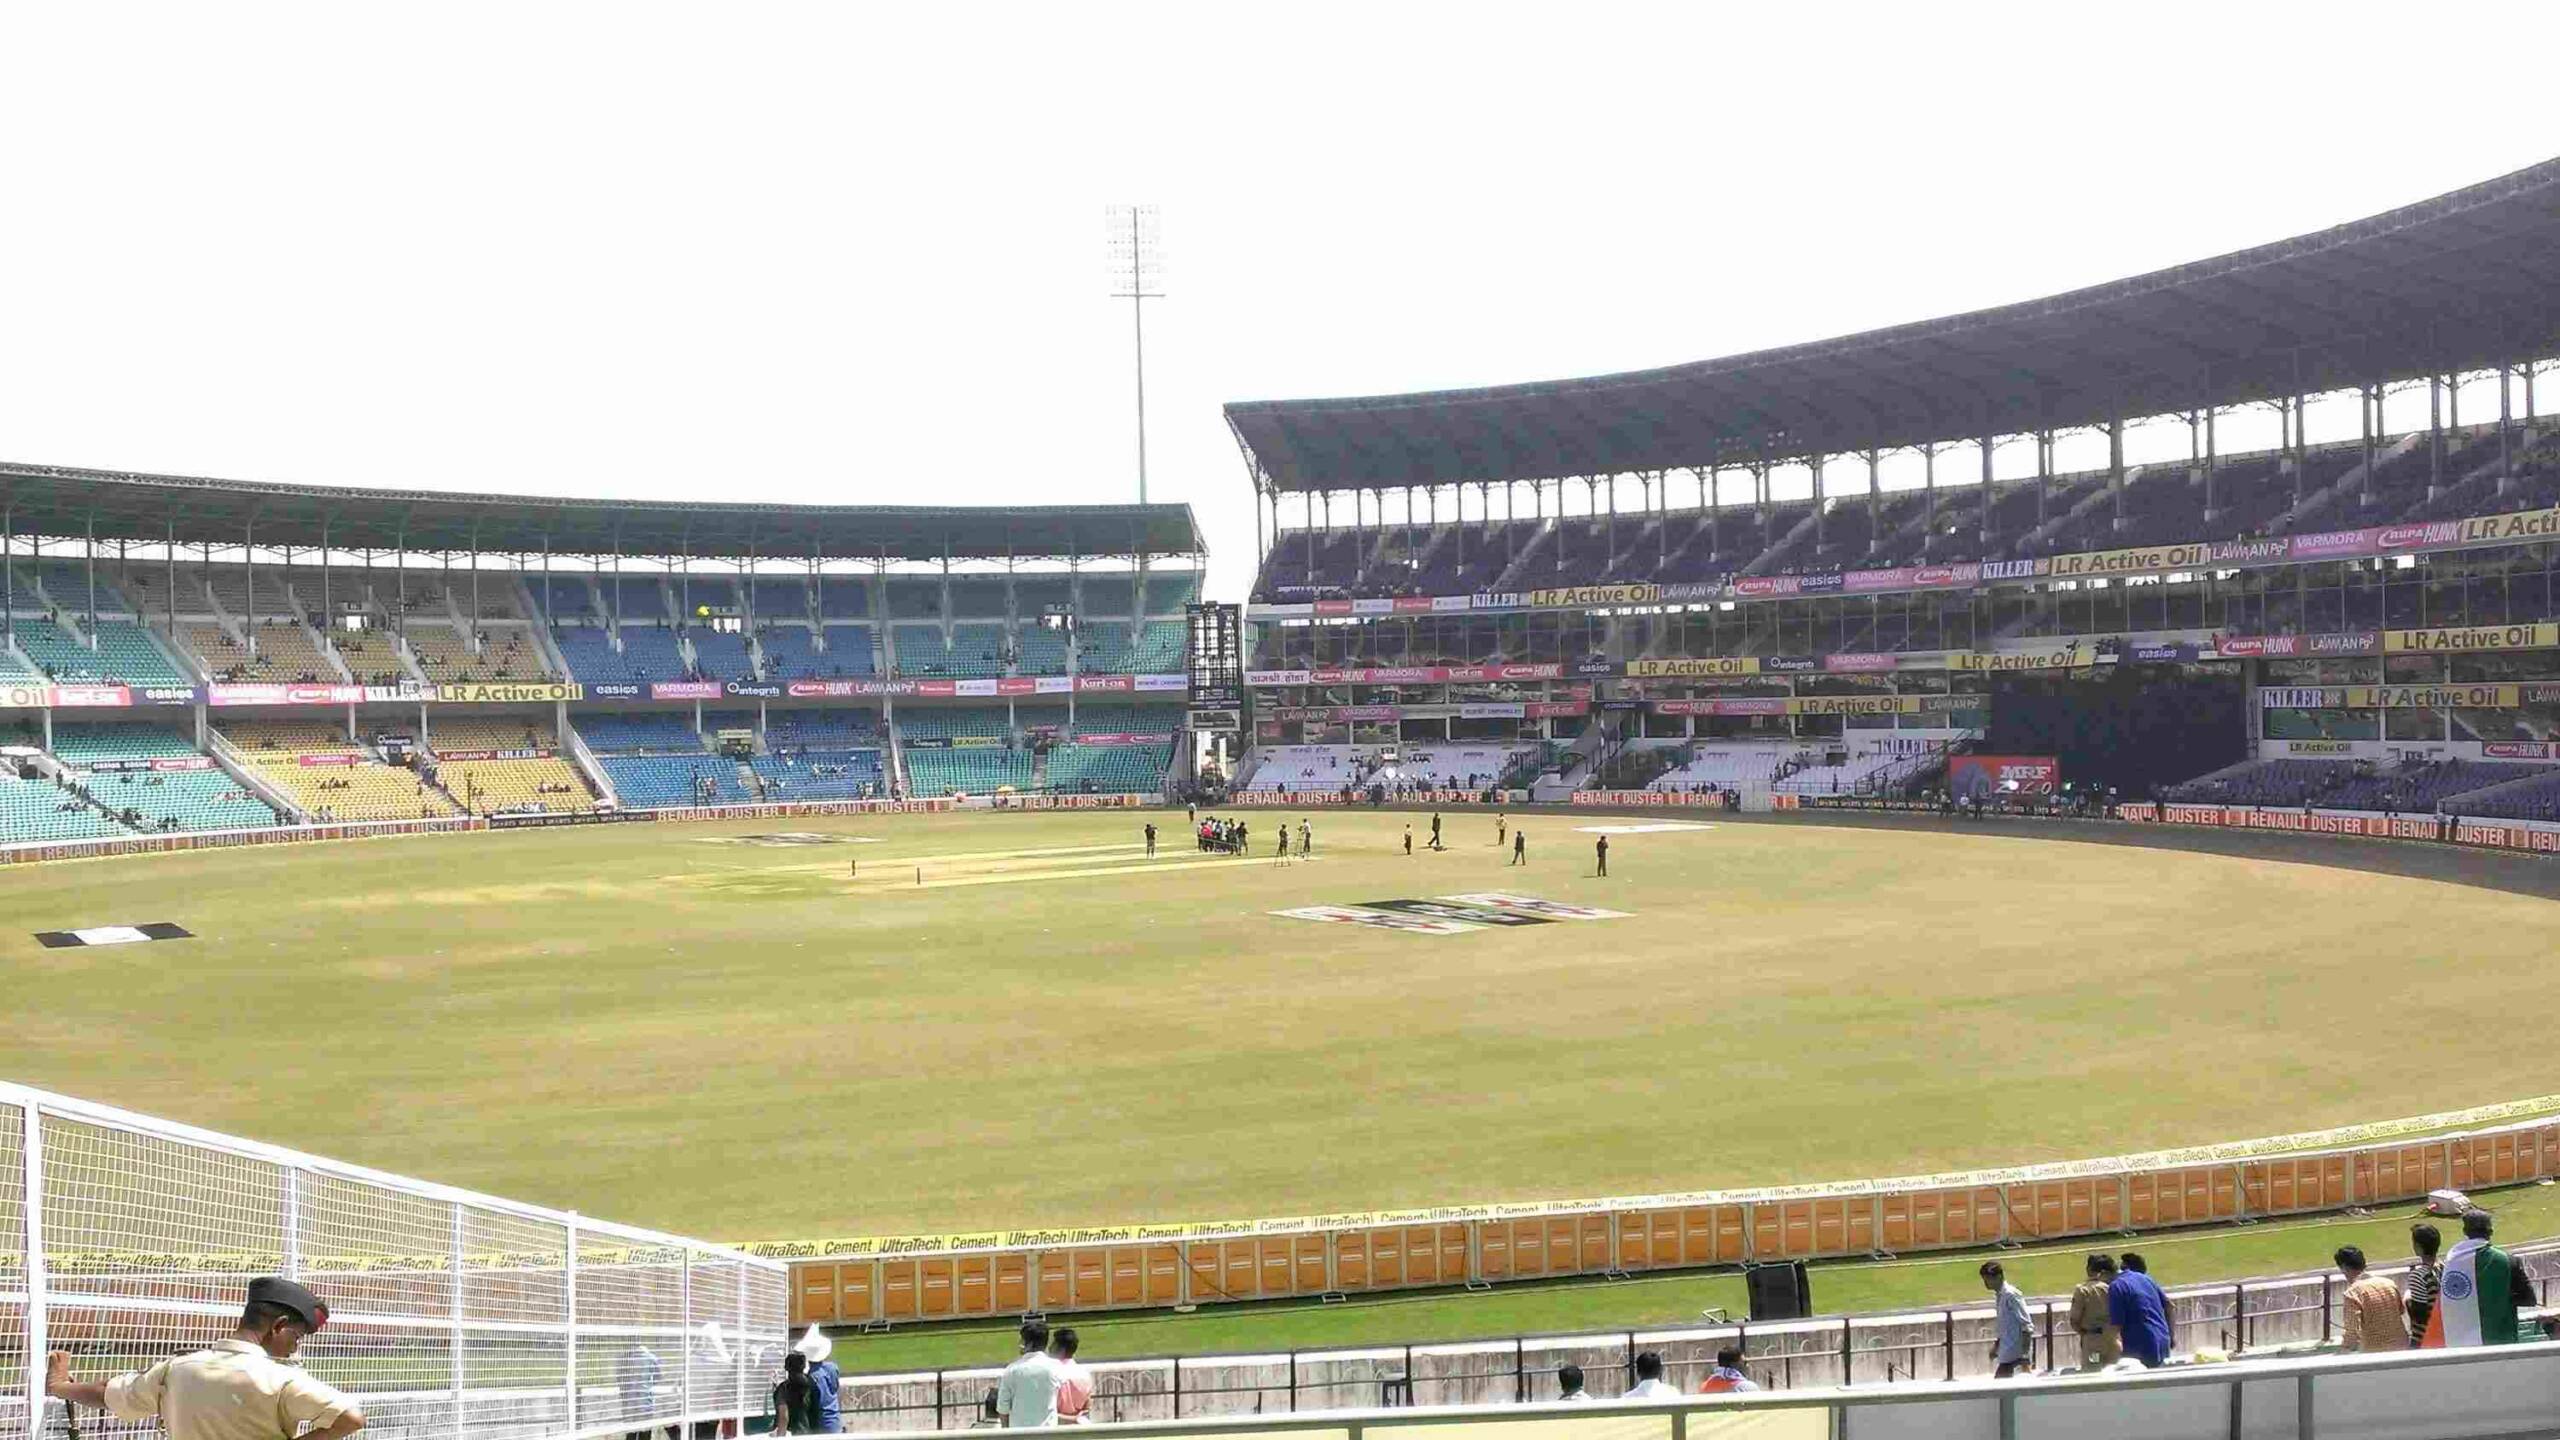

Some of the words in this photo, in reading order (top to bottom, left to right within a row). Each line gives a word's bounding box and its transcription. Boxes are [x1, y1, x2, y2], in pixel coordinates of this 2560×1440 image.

[2423, 521, 2460, 544] HUNK
[2465, 518, 2500, 541] LR
[2296, 531, 2366, 548] VARMORA
[1982, 559, 2034, 579] KILLER
[2055, 555, 2082, 575] LR
[2088, 551, 2160, 572] Active
[2167, 546, 2202, 567] Oil
[1471, 593, 1519, 608] KILLER
[1533, 590, 1557, 606] LR
[1563, 587, 1624, 604] Active
[1629, 585, 1658, 602] Oil
[2262, 637, 2295, 654] HUNK
[2310, 636, 2358, 652] LAWMAN
[2403, 631, 2429, 650] LR
[2434, 629, 2501, 648] Active
[2506, 626, 2536, 646] Oil
[1639, 661, 1658, 675] LR
[1665, 660, 1716, 675] Active
[1720, 659, 1744, 673] Oil
[1961, 654, 1984, 670] LR
[1989, 652, 2046, 669] Active
[2050, 650, 2076, 667] Oil
[653, 683, 713, 694] VARMORA
[825, 682, 852, 695] HUNK
[1081, 677, 1126, 689] Kurl-on
[11, 687, 46, 705] Oil
[439, 685, 469, 701] LR
[474, 684, 544, 701] Active
[549, 683, 581, 700] Oil
[2264, 689, 2323, 708] KILLER
[2366, 687, 2391, 706] LR
[2395, 686, 2463, 706] Active
[2468, 686, 2500, 706] Oil
[1800, 700, 1819, 713] LR
[1824, 698, 1876, 713] Active
[1880, 697, 1904, 711] Oil
[497, 750, 537, 760] KILLER
[2305, 743, 2334, 752] Active
[2518, 743, 2546, 758] HUNK
[2000, 765, 2052, 779] MRF
[1236, 791, 1293, 805] RENAULT
[1573, 791, 1619, 805] RENAULT
[1622, 792, 1665, 805] DUSTER
[657, 808, 720, 823] RENAULT
[725, 806, 779, 820] DUSTER
[811, 803, 870, 817] RENAULT
[875, 801, 927, 814] DUSTER
[2166, 807, 2219, 825] DUSTER
[2250, 811, 2307, 831] RENAULT
[2311, 814, 2362, 833] DUSTER
[2393, 819, 2450, 840] RENAUT
[2456, 825, 2506, 846] DUSTER
[47, 840, 106, 861] RENAULT
[111, 838, 165, 854] DUSTER
[755, 1242, 815, 1257] UltraTech
[824, 1239, 873, 1255] Cement
[882, 1236, 942, 1252] UltraTech
[951, 1234, 998, 1250] Cement
[1008, 1230, 1067, 1246] UltraTech
[1070, 1229, 1129, 1243] UltraTech
[1137, 1226, 1184, 1240] Cement
[1193, 1222, 1251, 1236] UltraTech
[1260, 1220, 1305, 1232] Cement
[1314, 1215, 1371, 1229] UltraTech
